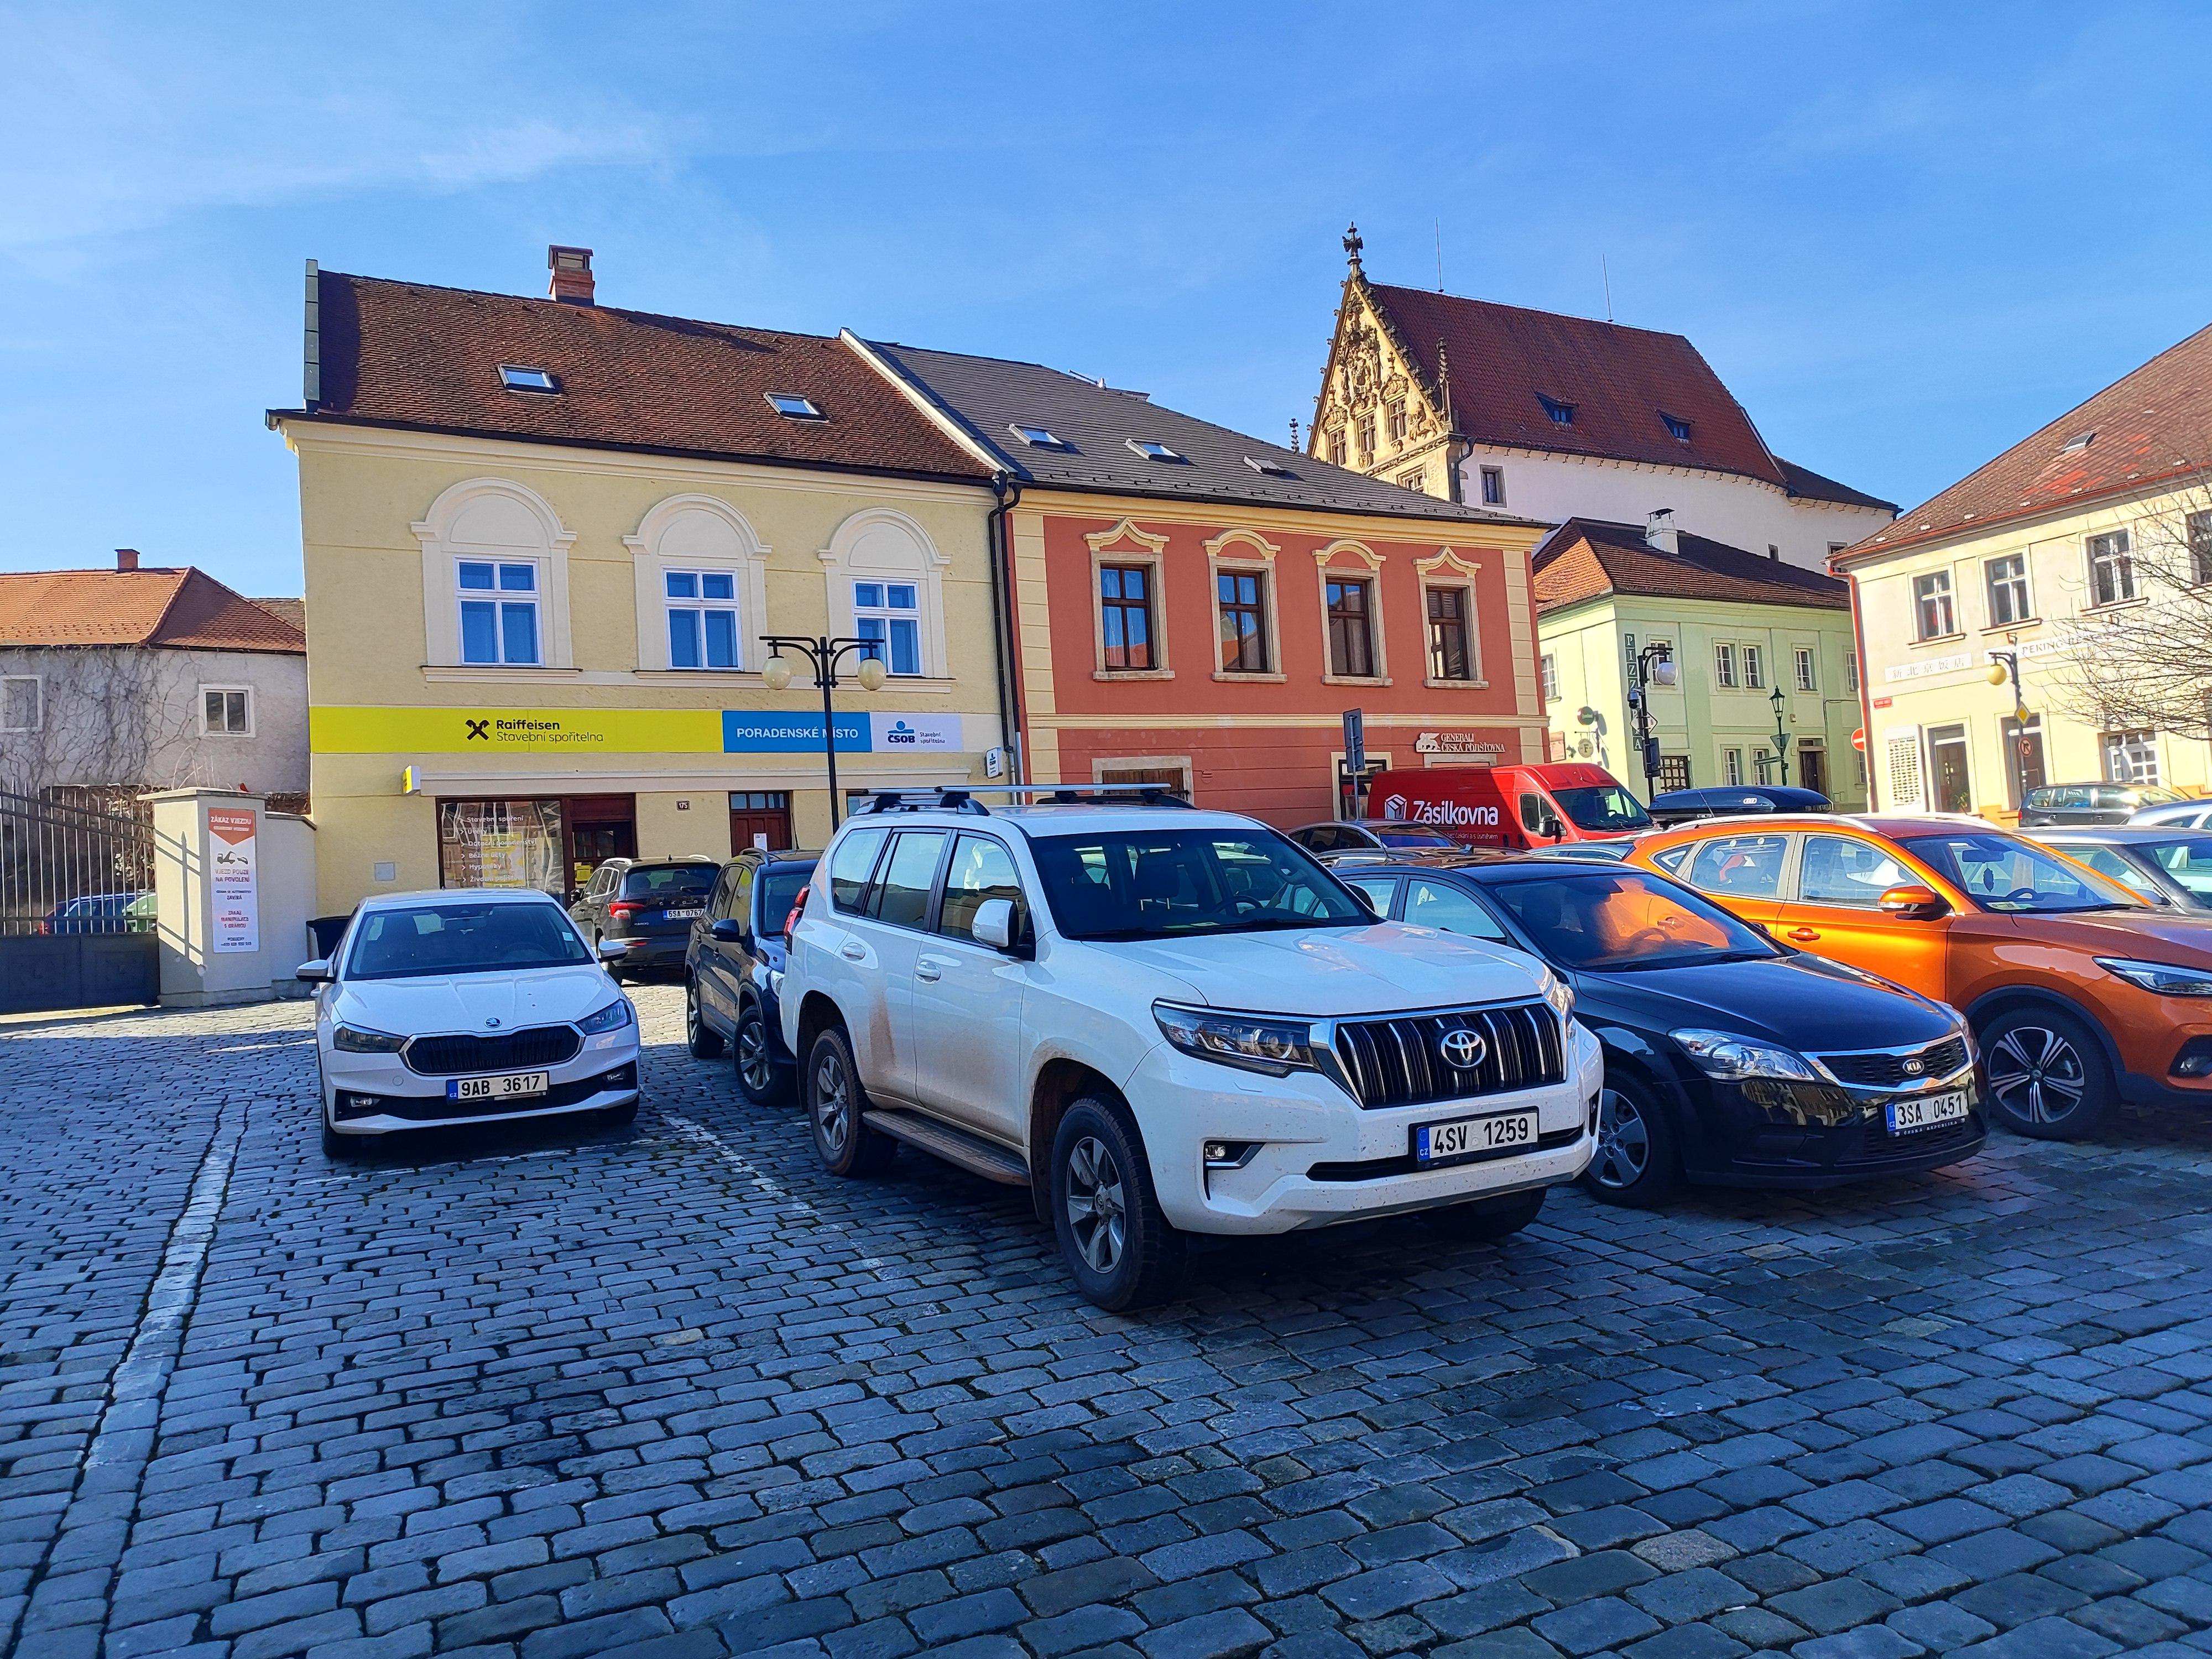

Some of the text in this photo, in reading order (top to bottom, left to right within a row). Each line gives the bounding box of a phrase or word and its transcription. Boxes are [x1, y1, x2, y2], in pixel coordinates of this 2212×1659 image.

[2022, 640, 2063, 655] PEKING
[1626, 635, 1642, 750] PIZZRA
[496, 719, 560, 730] Raiffeisen
[497, 731, 603, 744] Stavební spořitelna
[737, 726, 819, 738] PORADENSKÉ
[1441, 733, 1474, 742] GENERALI
[888, 734, 915, 743] ČSOB
[1441, 742, 1463, 752] ČESKÁ
[1413, 800, 1498, 825] Zásilkovna
[211, 815, 229, 823] ZÁKAZ
[498, 815, 524, 823] spoření
[1906, 1061, 1922, 1071] KIA
[461, 1075, 540, 1097] 9AB 3617
[1897, 1094, 1962, 1125] 3SA 0451
[1434, 1117, 1528, 1154] 4SV 1259
[1420, 1147, 1429, 1156] CZ
